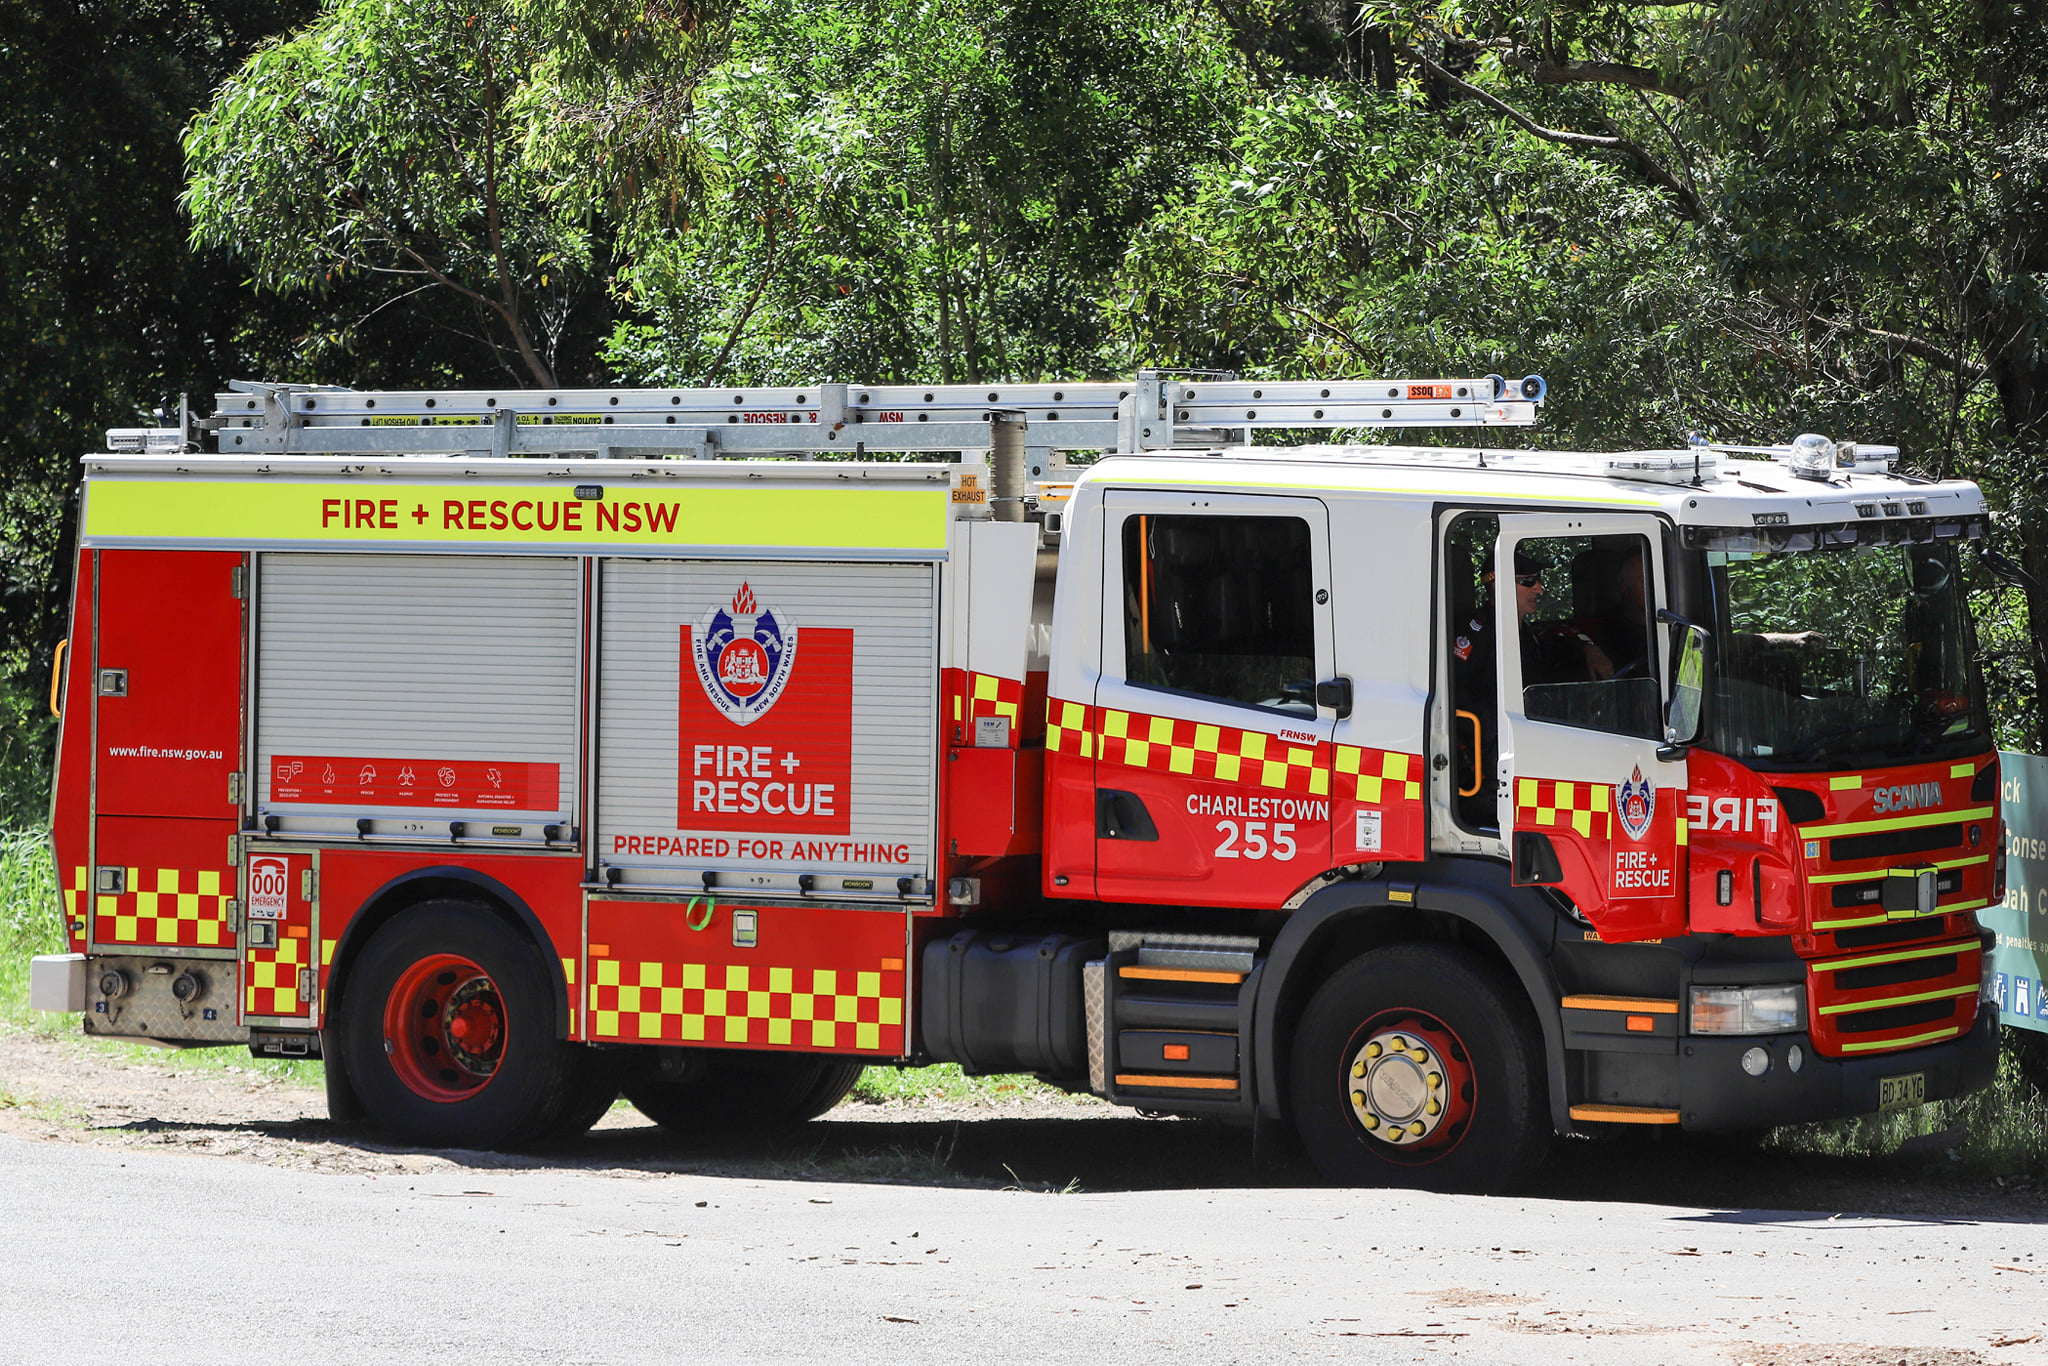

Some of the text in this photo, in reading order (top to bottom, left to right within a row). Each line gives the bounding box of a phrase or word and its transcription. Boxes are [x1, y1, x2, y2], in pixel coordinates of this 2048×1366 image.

[1412, 386, 1433, 397] boss
[573, 417, 602, 425] CAUTION
[743, 413, 787, 424] RESCUE
[880, 412, 904, 423] NSW
[961, 476, 977, 487] HOT
[952, 490, 985, 502] EXHAUST
[322, 499, 680, 533] FIRE + RESCUE NSW
[695, 639, 731, 713] FIRE AND RESCUE
[753, 636, 794, 713] NEW SOUTH WALES
[1280, 729, 1317, 742] FRNSW
[109, 745, 223, 760] www.fire.nsw.gov.au
[693, 745, 772, 778] FIRE
[693, 781, 835, 816] RESCUE
[1873, 781, 1944, 813] SCANIA
[1186, 794, 1329, 821] CHARLESTOWN
[614, 835, 910, 863] PREPARED FOR ANYTHING
[1214, 820, 1296, 861] 255
[1616, 851, 1647, 869] FIRE
[252, 873, 285, 896] 000
[1615, 869, 1670, 888] RESCUE
[251, 896, 285, 907] EMERGENCY
[2006, 935, 2037, 951] penalties
[99, 1003, 105, 1012] 3
[206, 1010, 213, 1019] 4
